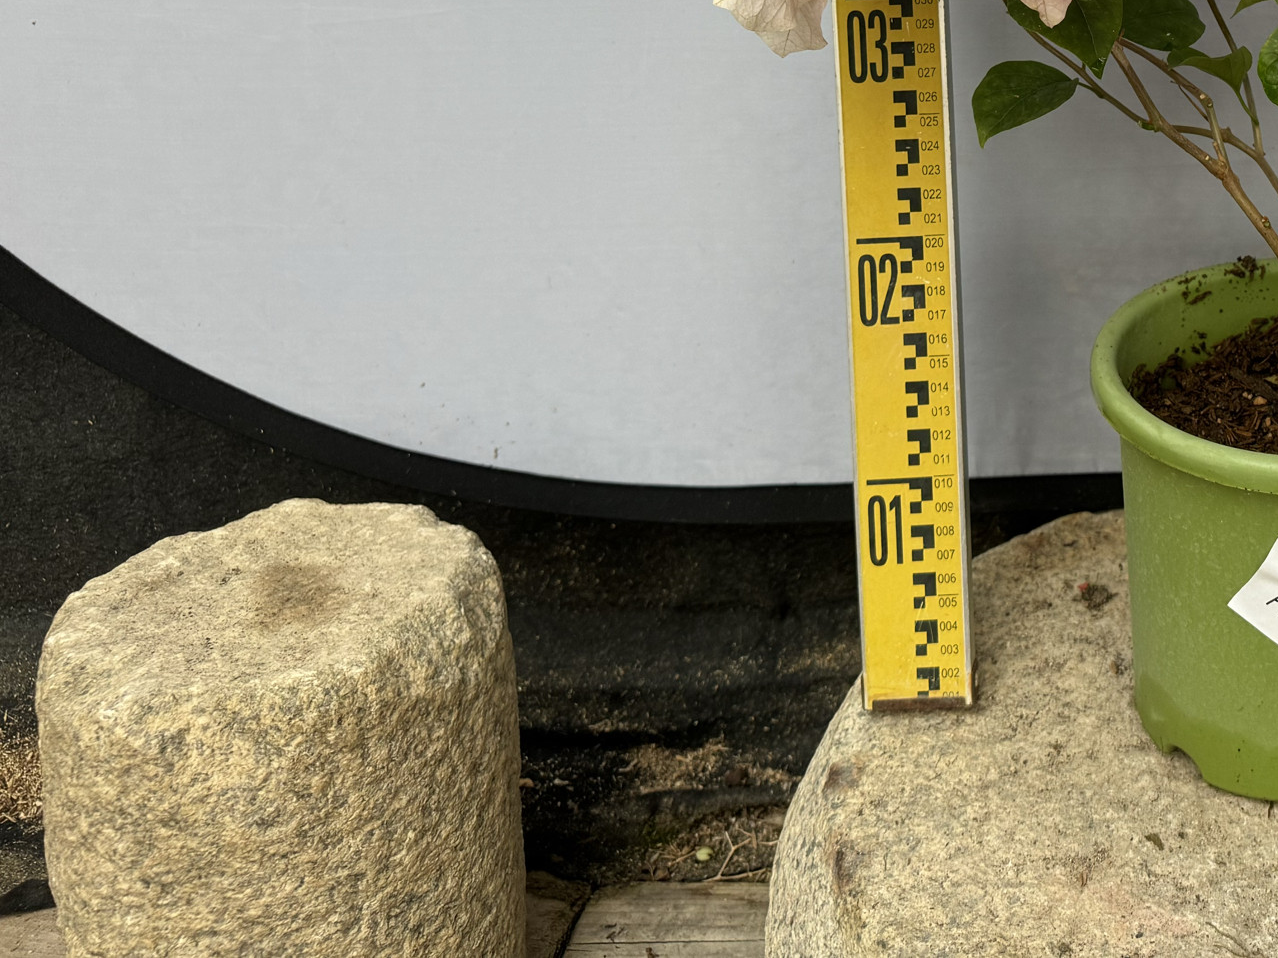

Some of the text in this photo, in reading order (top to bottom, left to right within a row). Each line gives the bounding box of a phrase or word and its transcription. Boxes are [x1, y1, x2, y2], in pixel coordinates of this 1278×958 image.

[915, 19, 934, 29] 029
[847, 9, 889, 83] 03
[916, 43, 935, 54] 028
[918, 68, 936, 78] 027
[919, 92, 938, 102] 026
[920, 116, 939, 127] 025
[921, 141, 939, 151] 024
[922, 165, 941, 175] 023
[923, 189, 942, 200] 022
[924, 213, 942, 224] 021
[925, 238, 944, 248] 020
[926, 262, 945, 272] 019
[858, 253, 900, 327] 02
[927, 286, 946, 296] 018
[928, 310, 946, 320] 017
[929, 334, 948, 344] 016
[929, 358, 948, 369] 015
[930, 382, 949, 392] 014
[931, 406, 950, 416] 013
[932, 430, 951, 441] 012
[933, 454, 950, 464] 011
[934, 478, 953, 488] 010
[935, 502, 954, 512] 009
[867, 494, 904, 566] 01
[936, 526, 954, 536] 008
[937, 549, 955, 560] 007
[938, 573, 956, 583] 006
[938, 597, 957, 608] 005
[939, 621, 958, 631] 004
[940, 644, 959, 654] 003
[941, 668, 960, 678] 002
